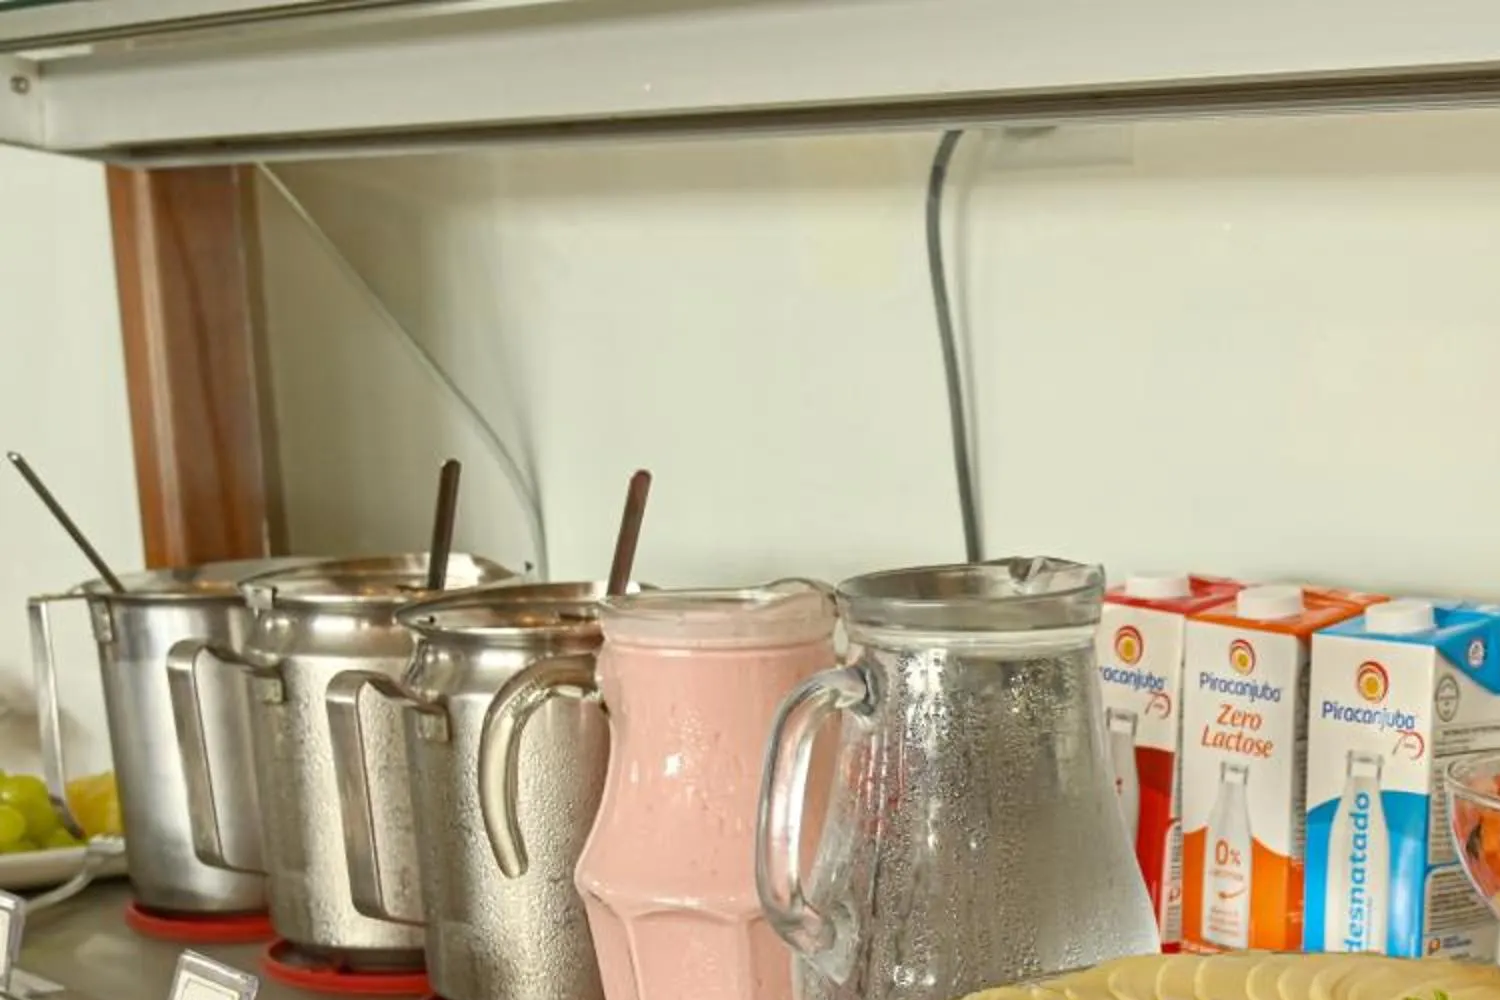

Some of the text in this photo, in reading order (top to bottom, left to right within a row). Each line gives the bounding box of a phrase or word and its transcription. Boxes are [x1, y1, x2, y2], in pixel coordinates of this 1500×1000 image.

[1099, 666, 1166, 691] acanjuba
[1199, 671, 1282, 702] Piracanjuba
[1216, 703, 1263, 731] Zero
[1321, 700, 1416, 732] Piracanjuba
[1201, 725, 1274, 759] Lactose
[1344, 792, 1370, 952] desnatado
